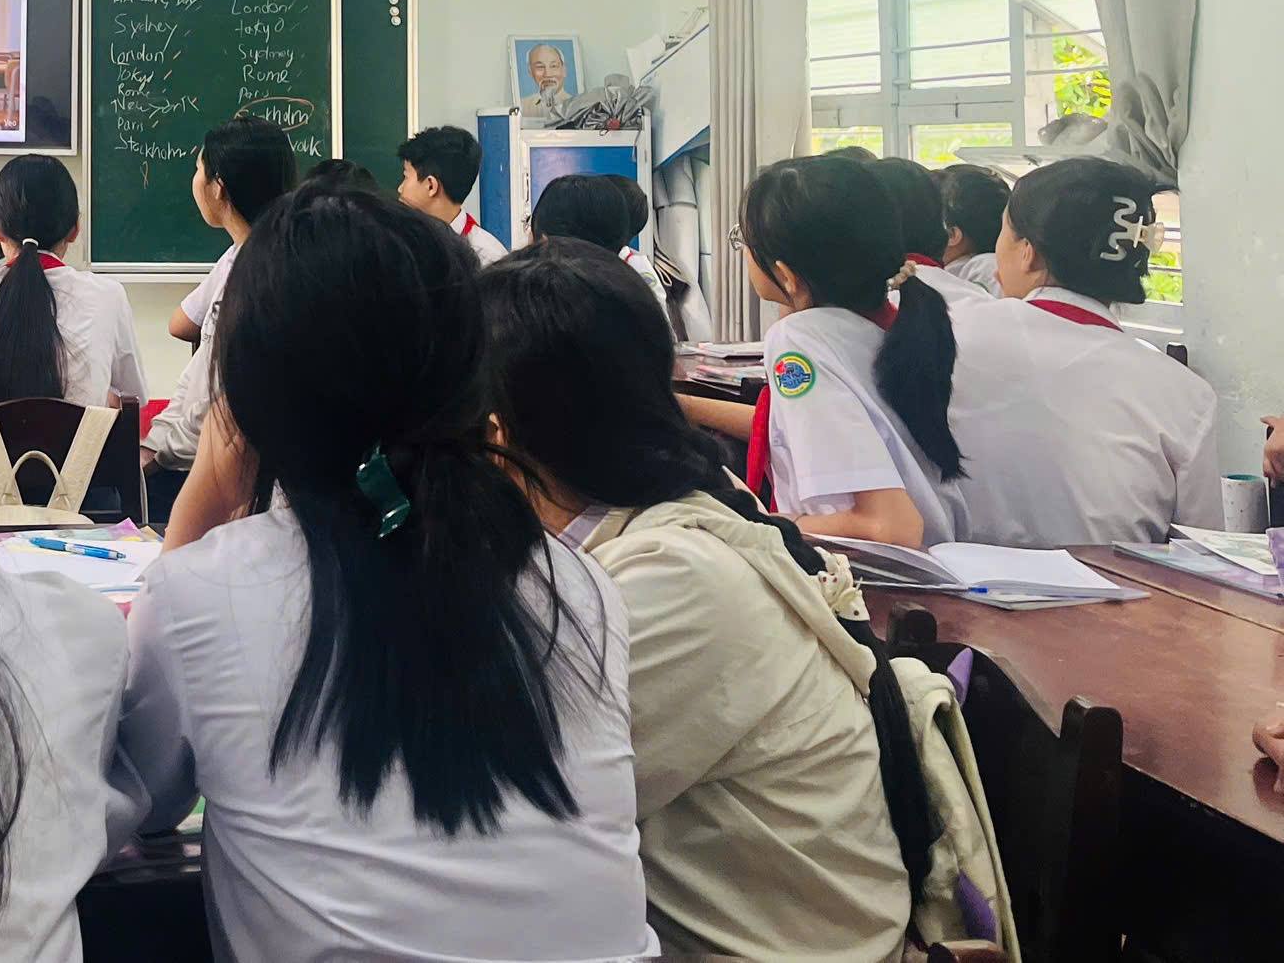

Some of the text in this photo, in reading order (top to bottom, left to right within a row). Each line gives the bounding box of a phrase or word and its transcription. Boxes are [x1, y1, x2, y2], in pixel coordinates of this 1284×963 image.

[114, 13, 178, 53] Sydney
[110, 41, 165, 64] London
[117, 116, 144, 133] Paris
